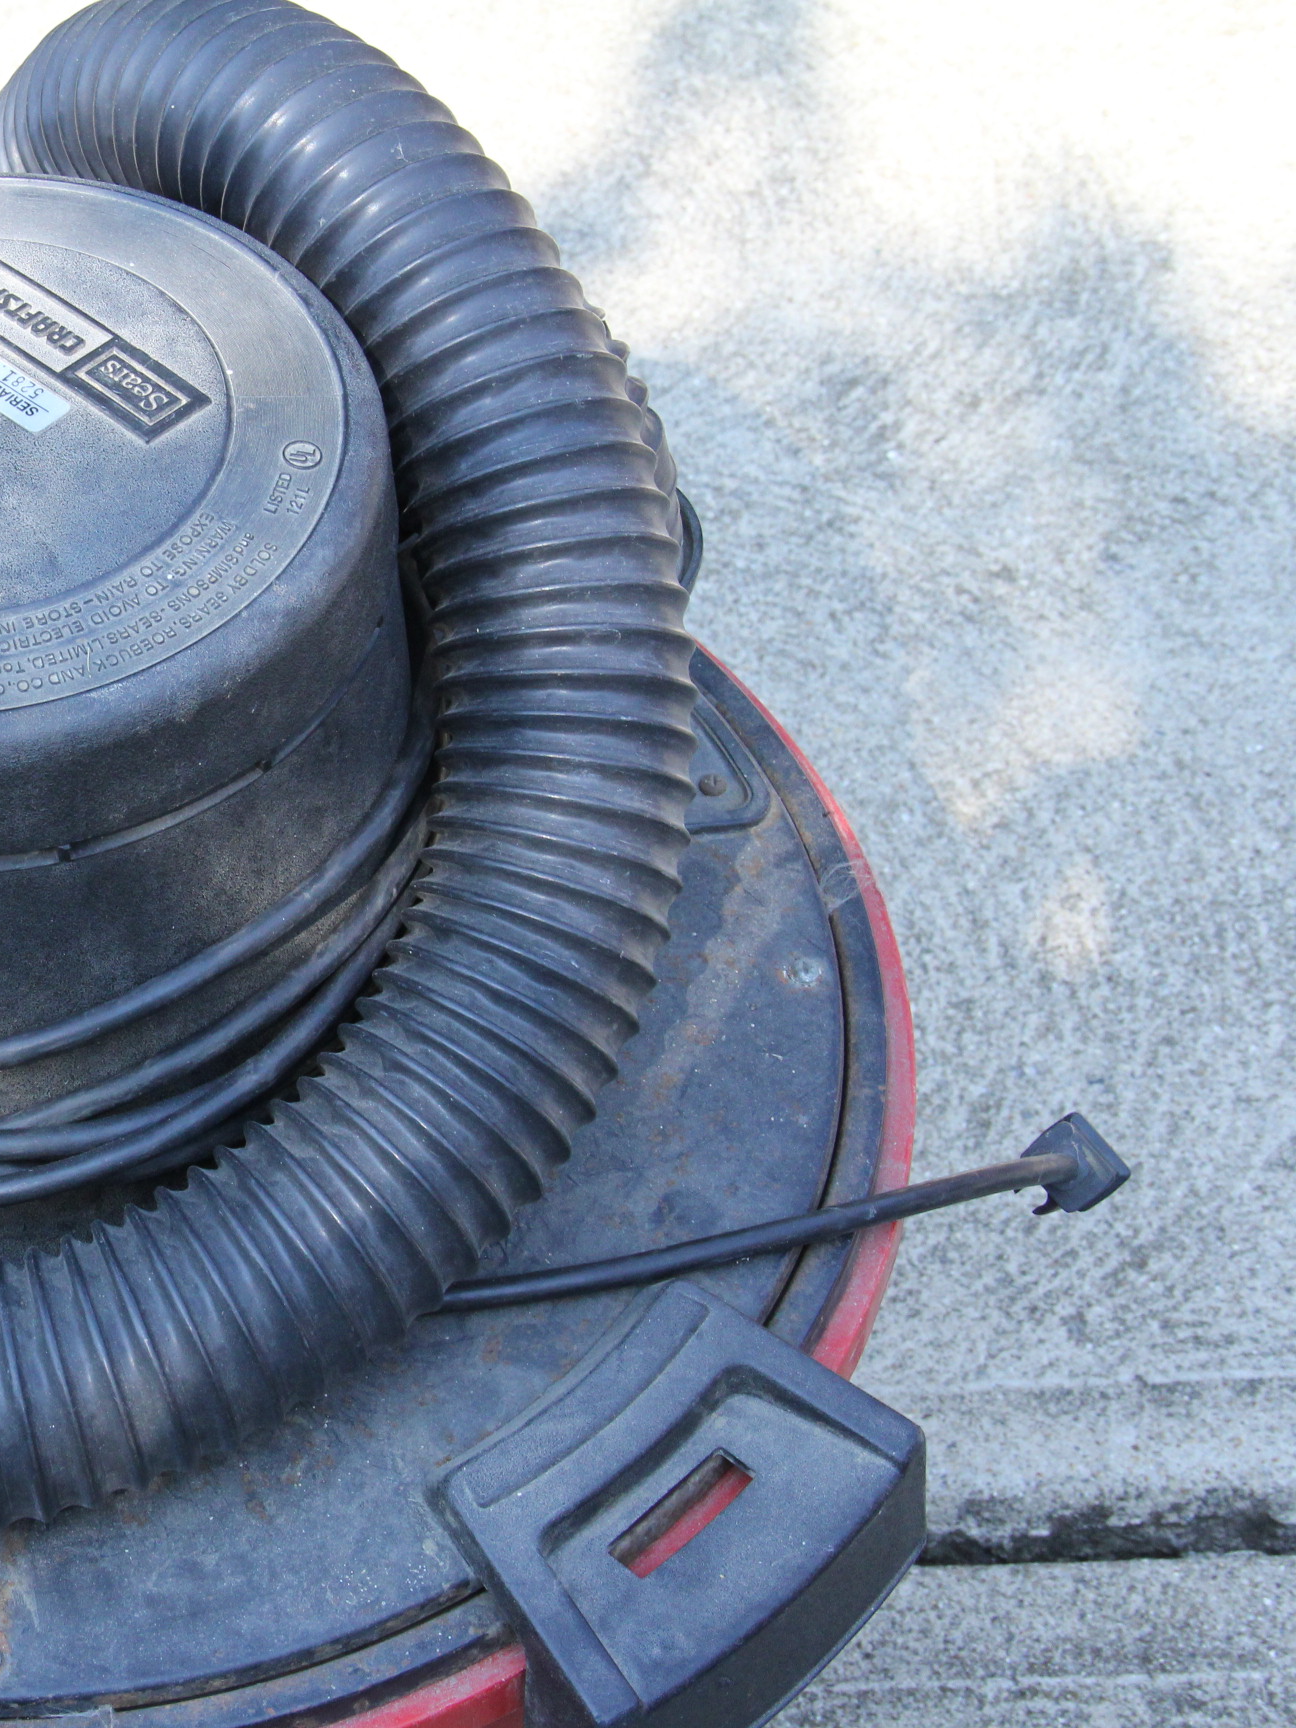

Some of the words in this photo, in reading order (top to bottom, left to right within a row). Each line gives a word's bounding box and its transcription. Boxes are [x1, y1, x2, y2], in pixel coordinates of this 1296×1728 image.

[99, 360, 169, 410] Sears
[264, 473, 292, 514] LISTED
[162, 512, 214, 561] EXPOSE
[233, 532, 254, 557] and
[140, 561, 163, 578] TO
[244, 542, 277, 576] SOLD
[145, 580, 169, 597] TO
[227, 574, 248, 594] BY
[90, 594, 141, 625] AVOID
[92, 626, 177, 672] ROEBUCK
[48, 665, 85, 685] AND
